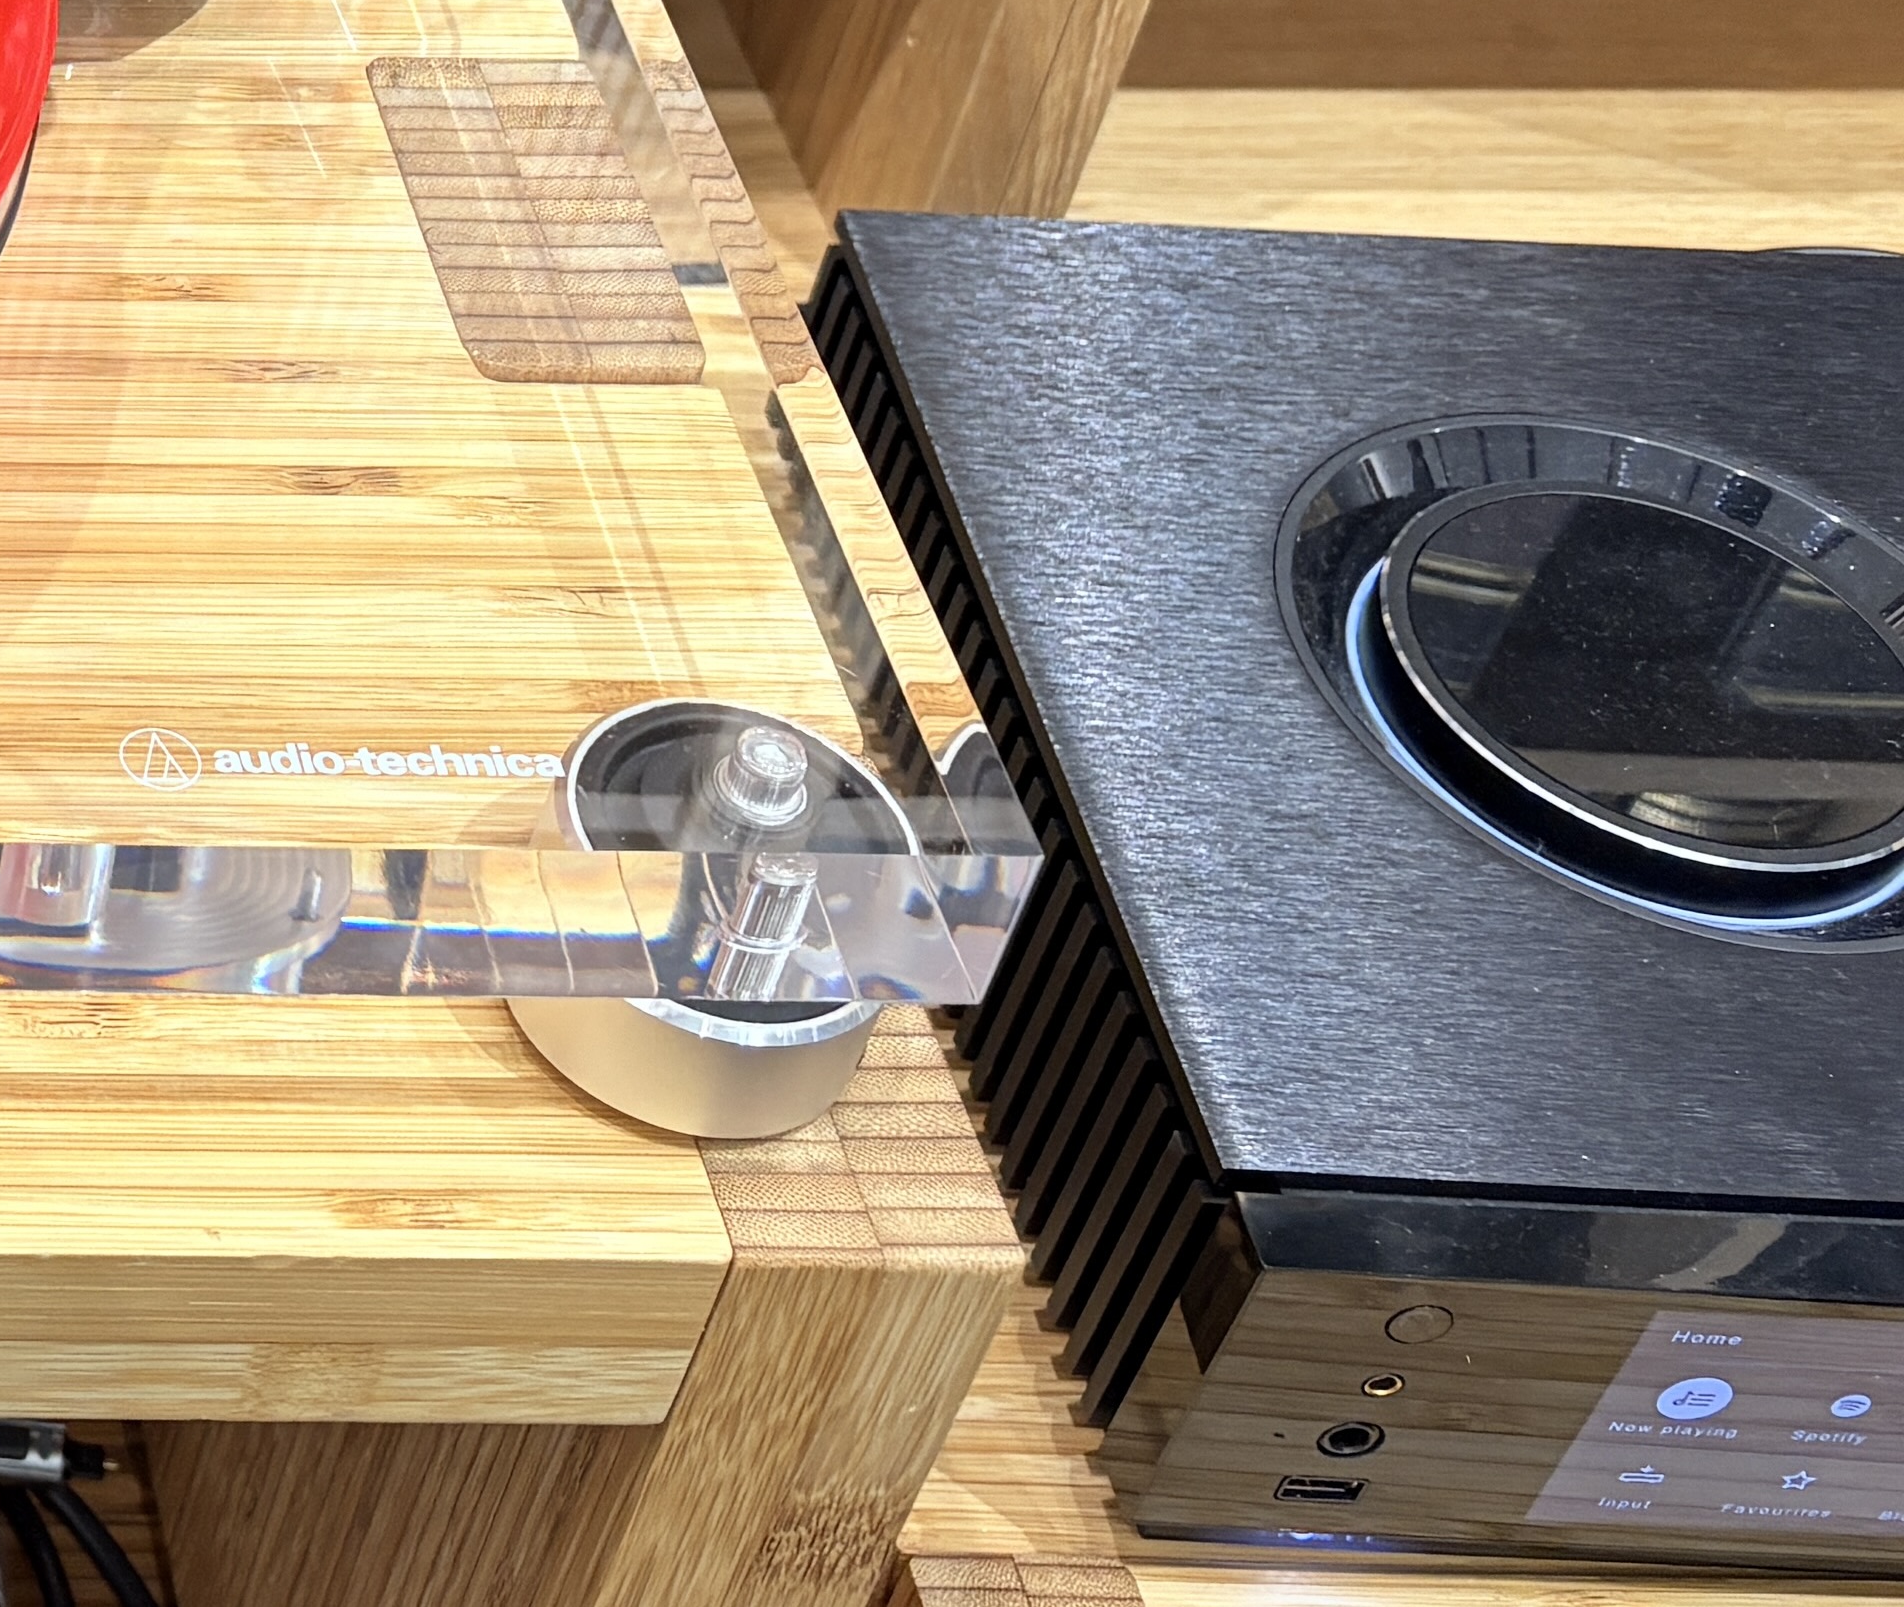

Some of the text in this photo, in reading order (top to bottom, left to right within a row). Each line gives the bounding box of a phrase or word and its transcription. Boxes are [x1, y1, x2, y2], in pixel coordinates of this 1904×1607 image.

[212, 743, 567, 778] audio-technica
[1672, 1330, 1742, 1346] Home
[1608, 1421, 1738, 1439] Now playing
[1791, 1429, 1868, 1445] Spotify
[1598, 1497, 1651, 1510] Input
[1721, 1503, 1832, 1519] Favourites
